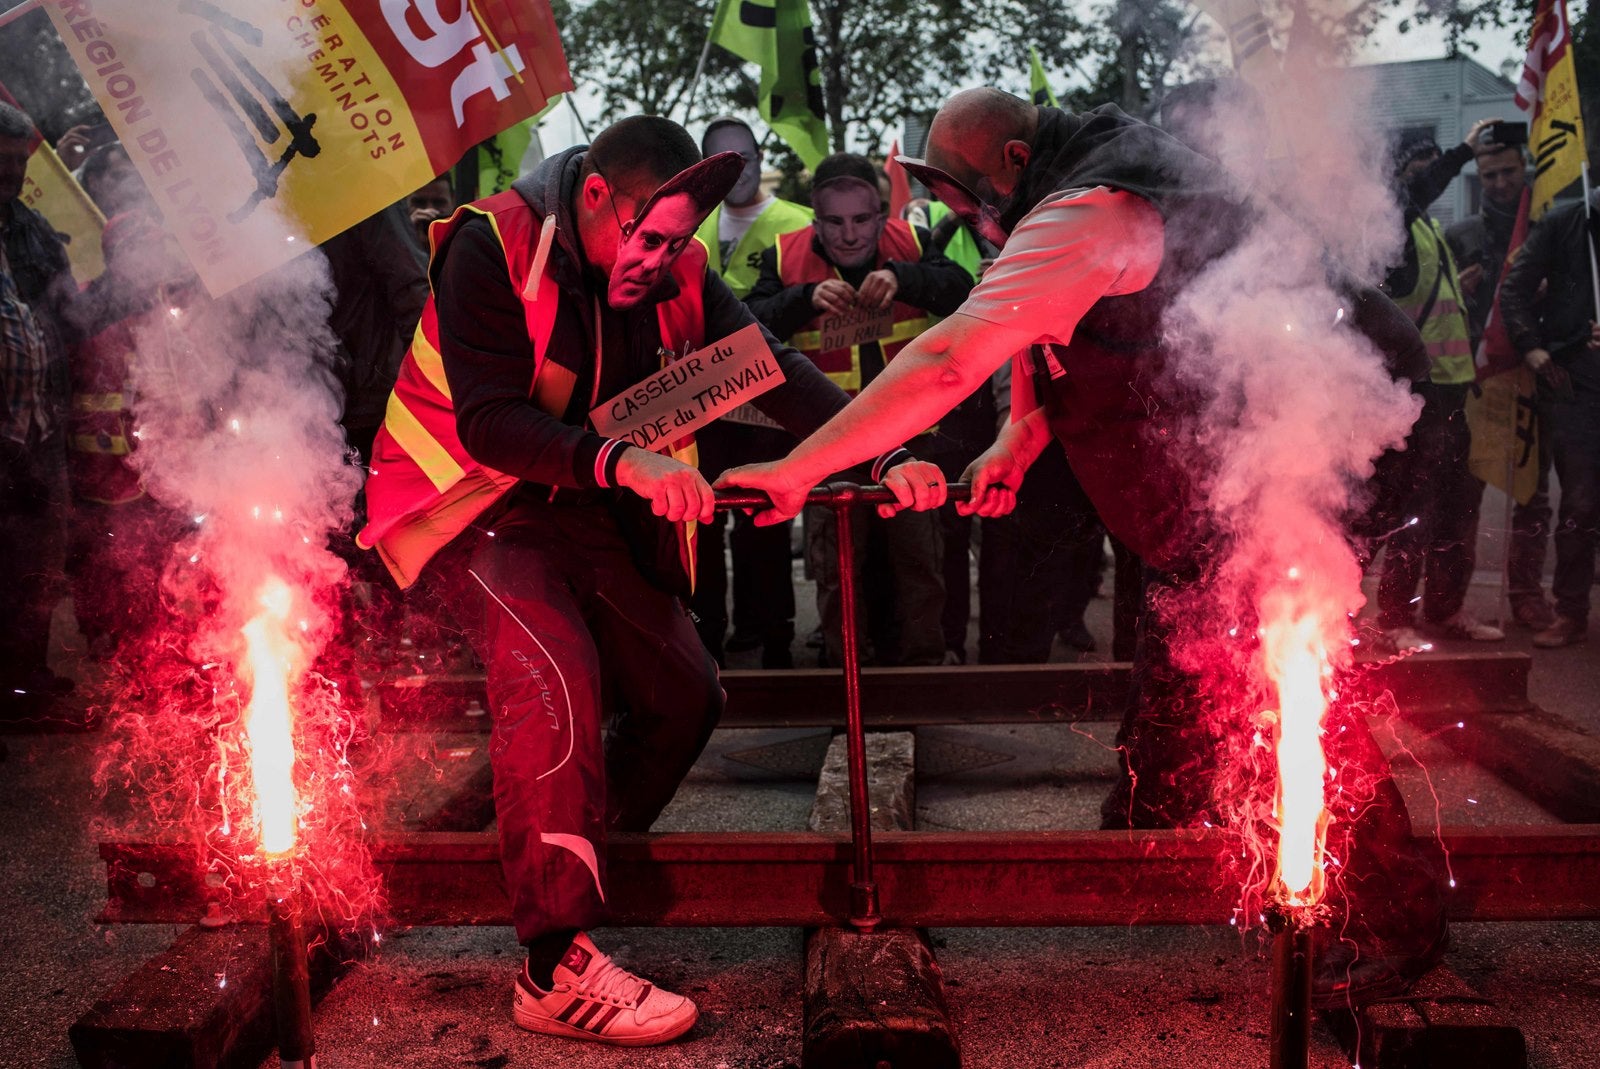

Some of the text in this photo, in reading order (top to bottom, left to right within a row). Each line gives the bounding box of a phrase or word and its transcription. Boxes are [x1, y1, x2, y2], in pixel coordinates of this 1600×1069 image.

[59, 0, 153, 125] RÉGION
[136, 128, 182, 177] DE
[286, 15, 387, 160] CHEMINOTS
[824, 322, 882, 352] DU RAIL
[611, 357, 704, 422] CASSEUR
[710, 346, 734, 365] du
[673, 408, 695, 427] du
